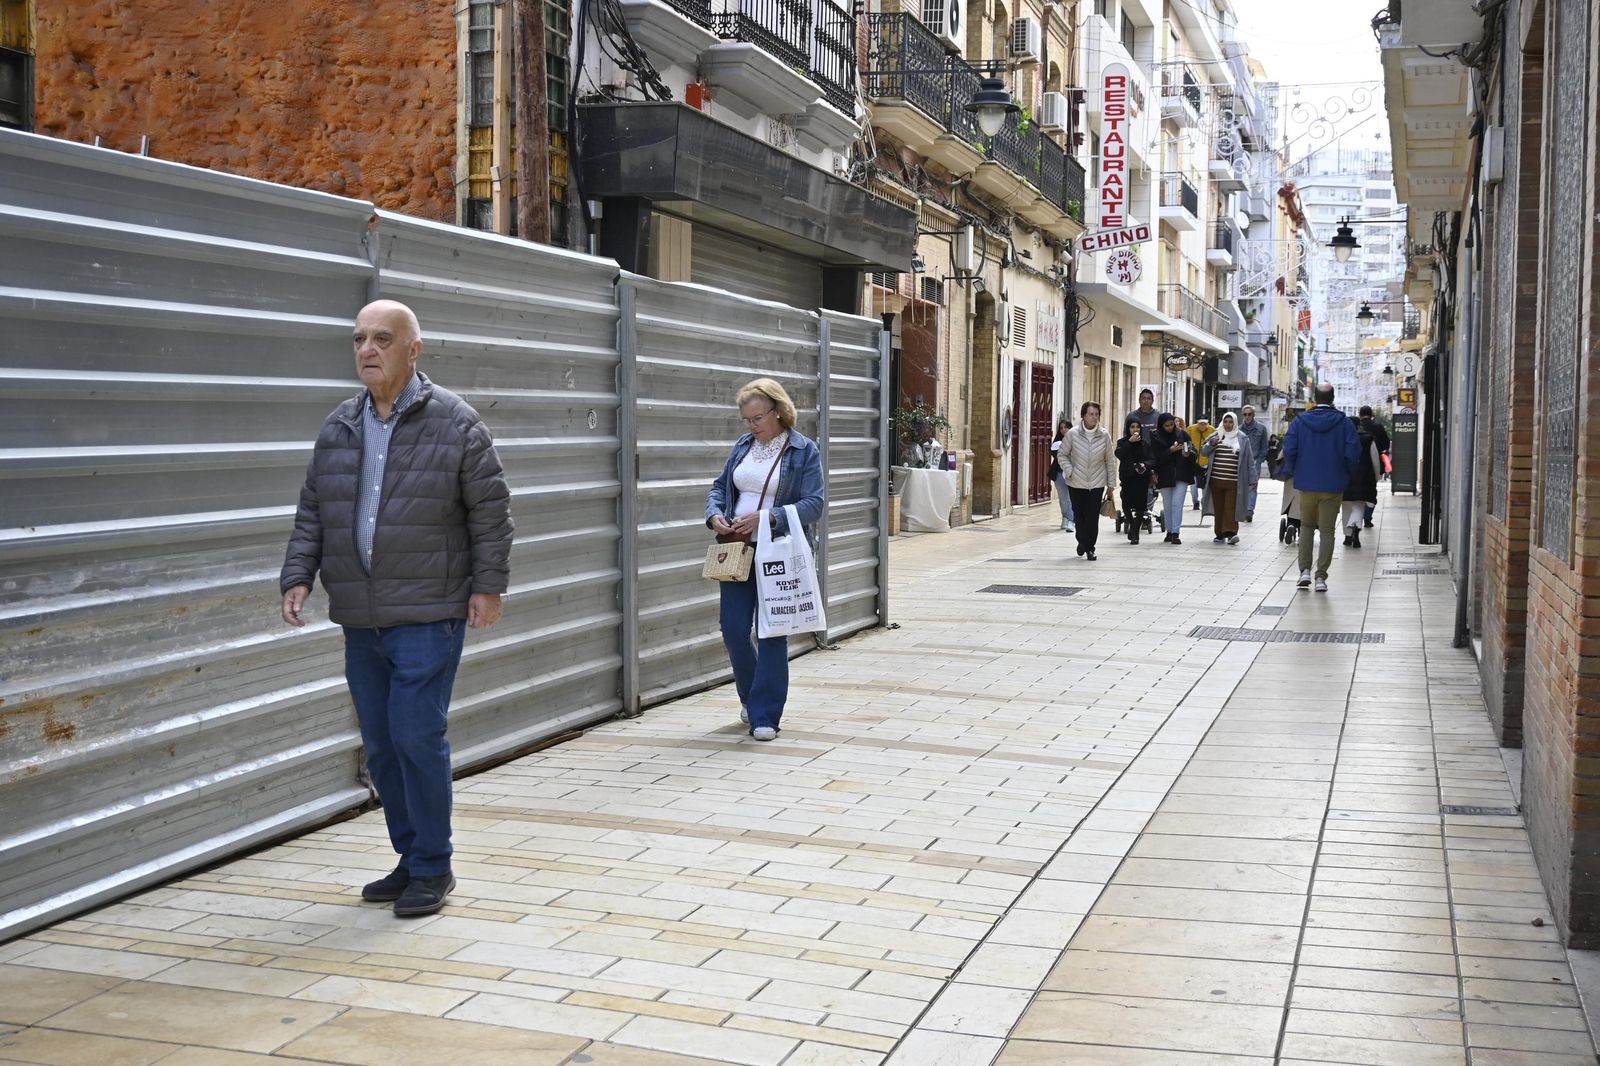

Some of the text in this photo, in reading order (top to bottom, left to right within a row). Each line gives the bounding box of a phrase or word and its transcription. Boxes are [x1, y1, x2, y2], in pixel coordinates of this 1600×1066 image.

[1102, 75, 1126, 227] RESTAURANTE
[1082, 227, 1149, 251] CHINO
[765, 564, 784, 575] Lee
[771, 605, 796, 615] ALMACENES
